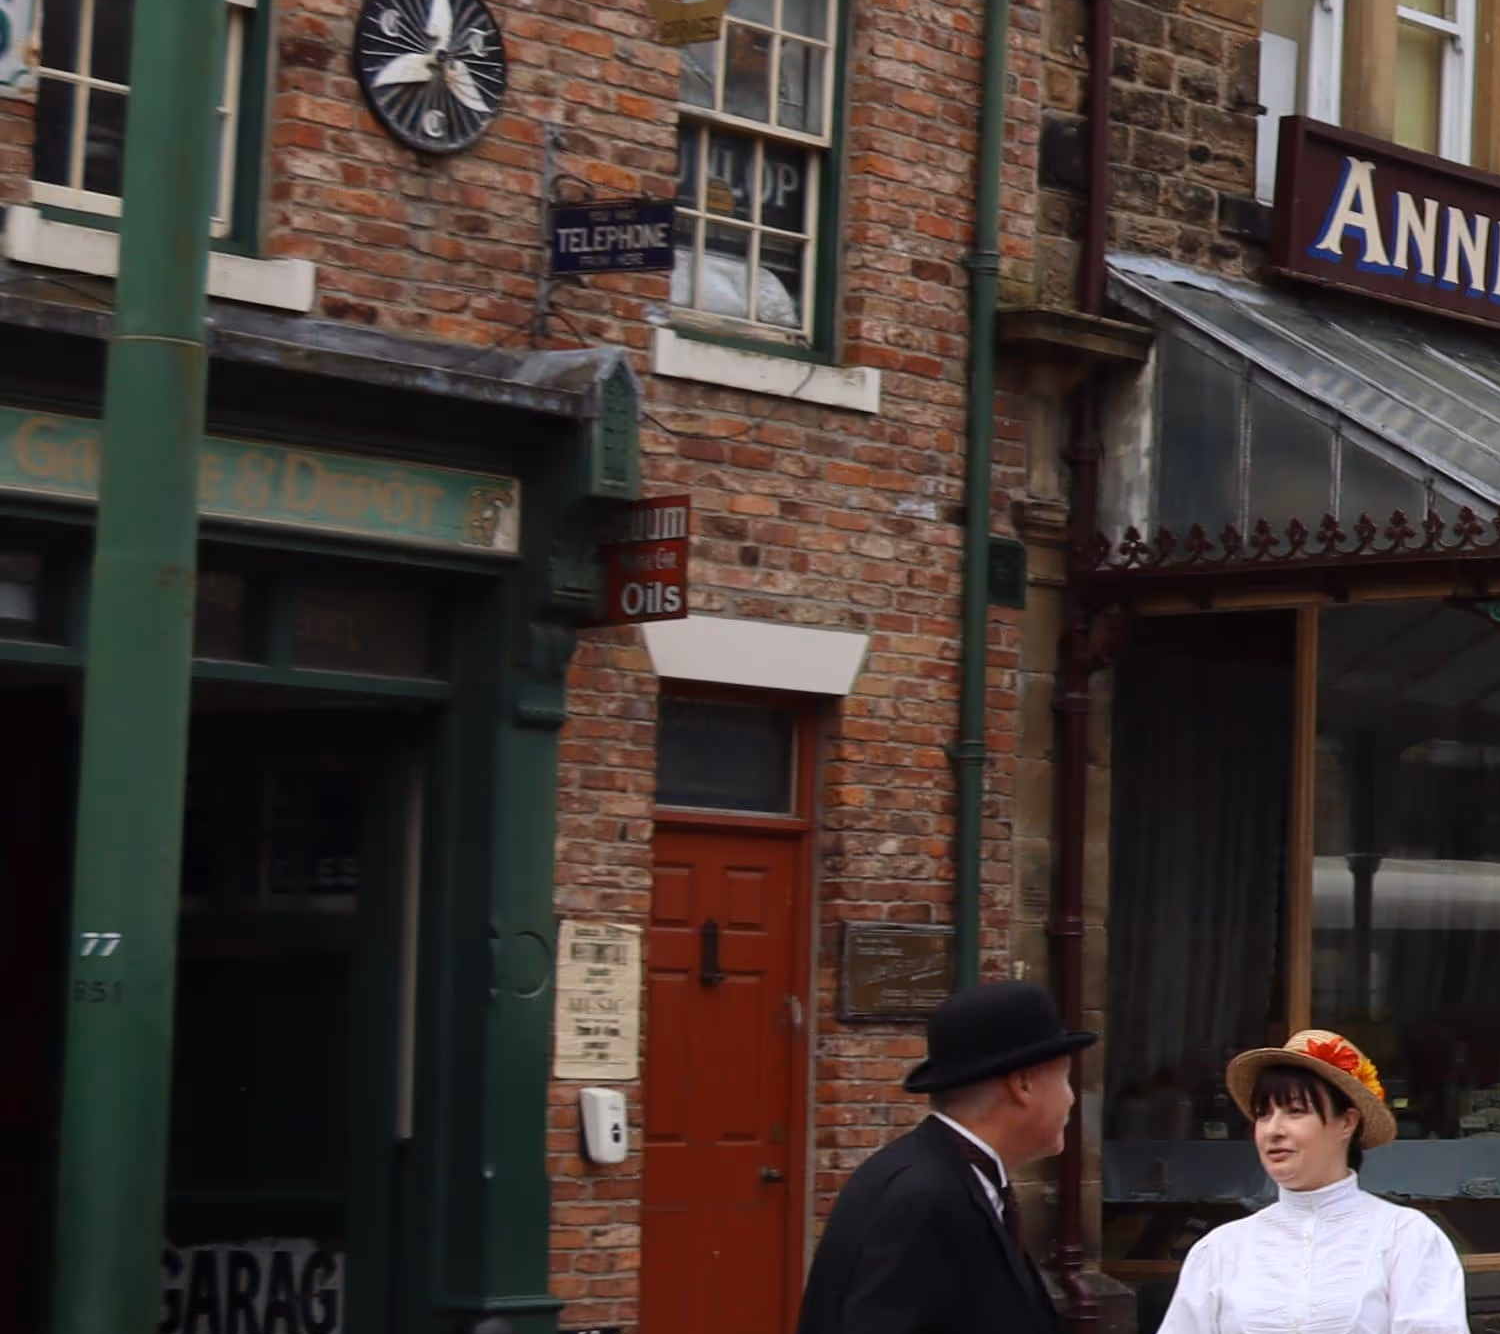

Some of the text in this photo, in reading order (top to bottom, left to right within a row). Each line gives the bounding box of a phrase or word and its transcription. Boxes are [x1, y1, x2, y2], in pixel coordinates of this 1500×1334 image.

[557, 222, 670, 254] TELEPHONE
[621, 581, 682, 616] Oils
[79, 931, 122, 957] 77
